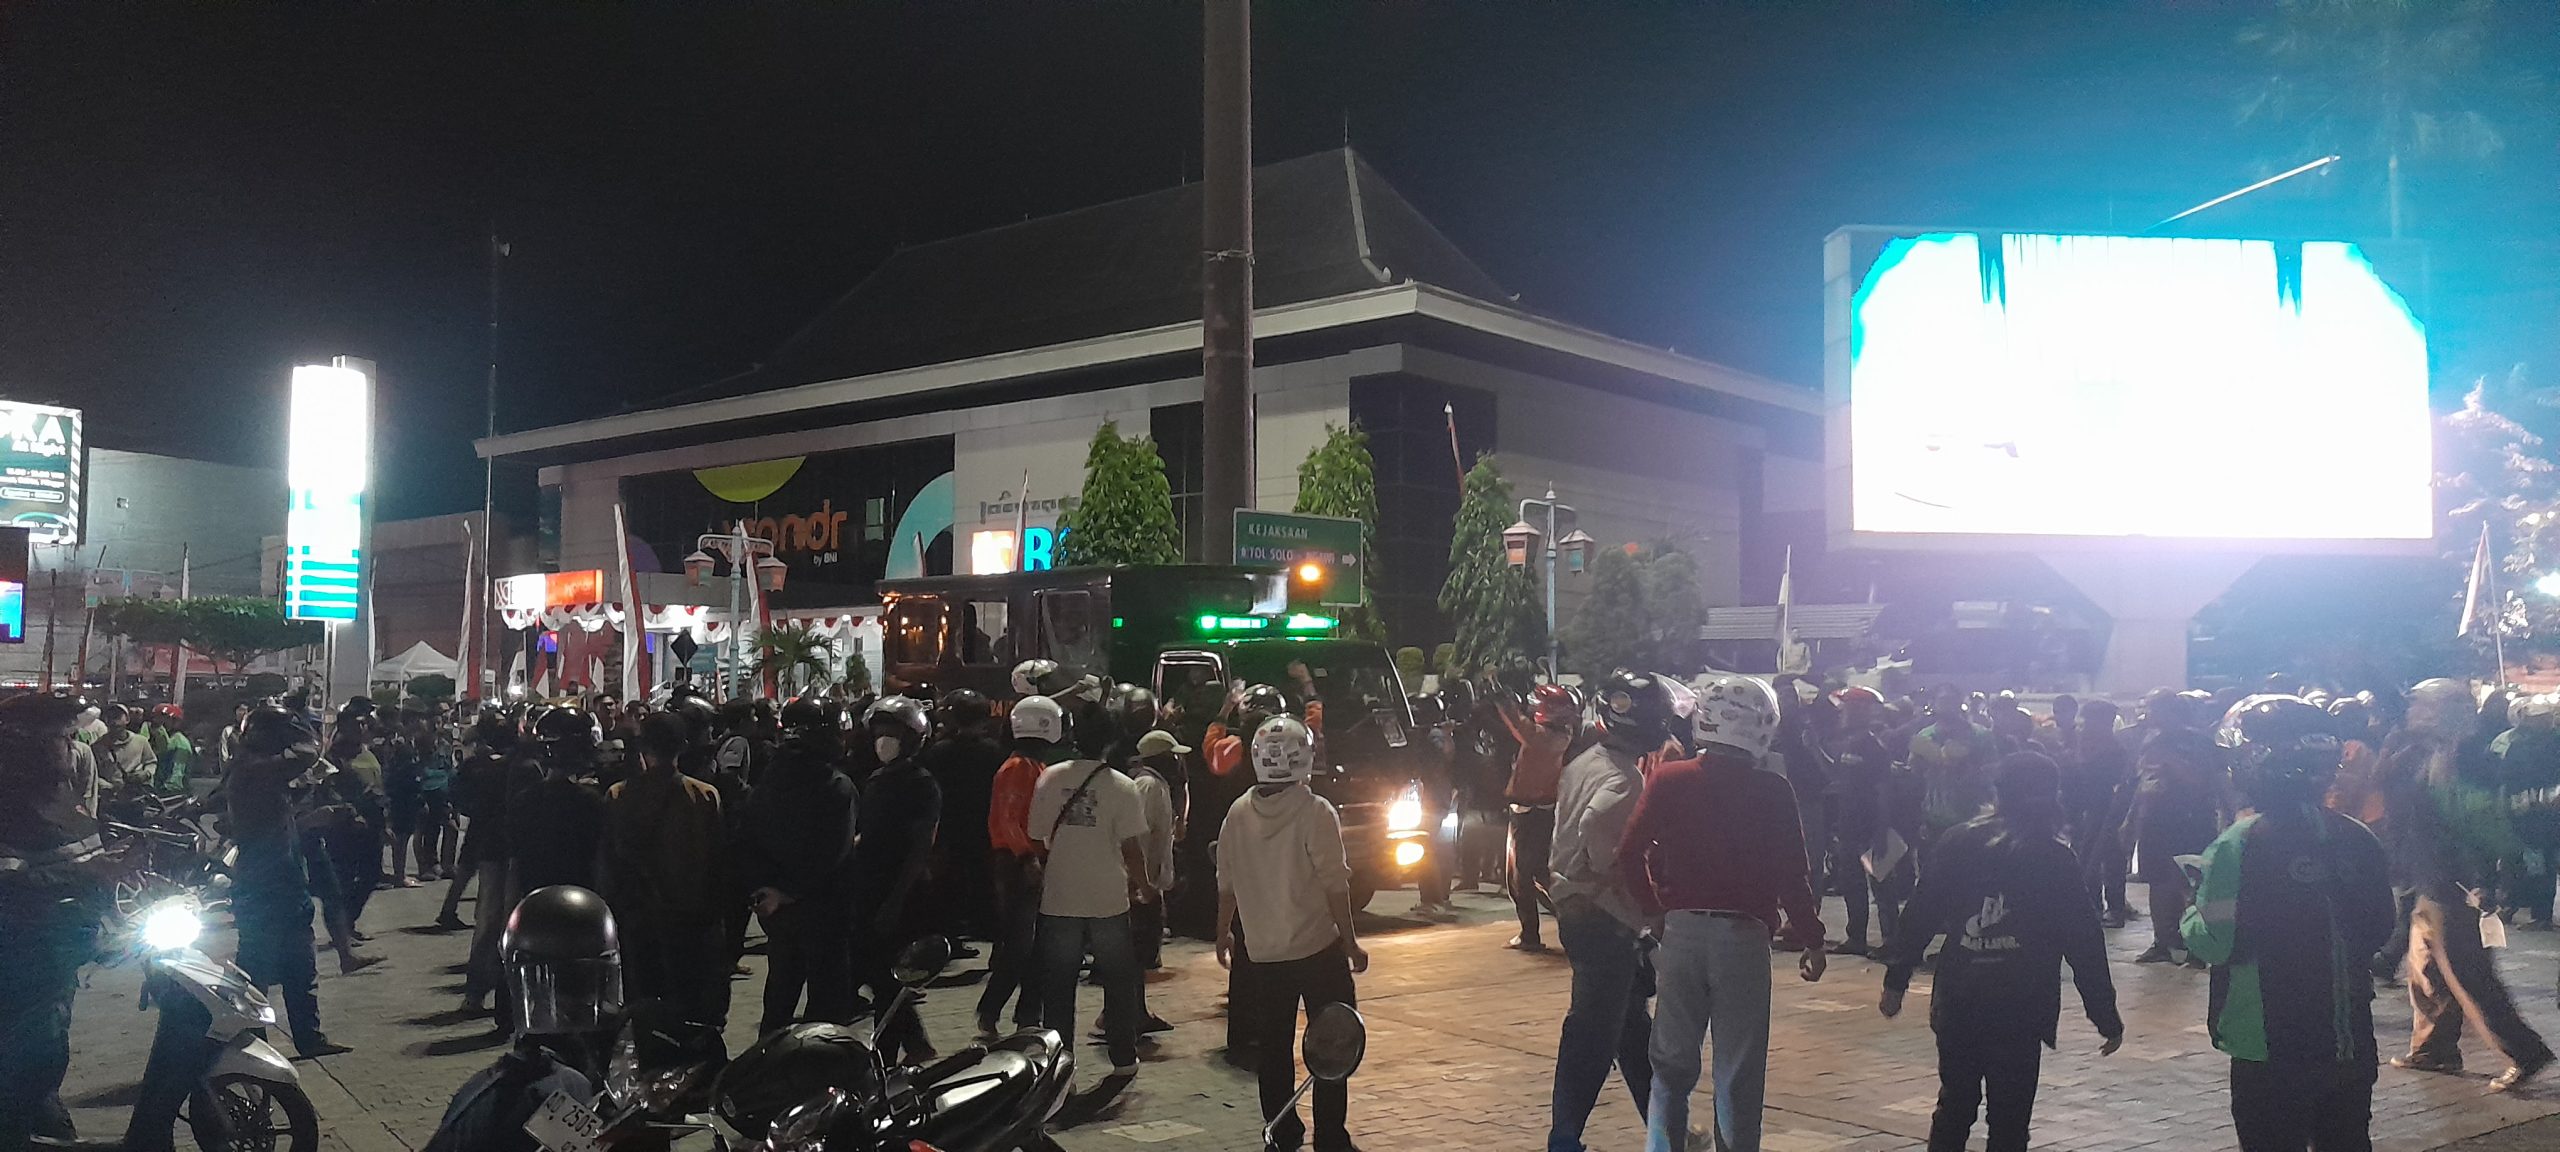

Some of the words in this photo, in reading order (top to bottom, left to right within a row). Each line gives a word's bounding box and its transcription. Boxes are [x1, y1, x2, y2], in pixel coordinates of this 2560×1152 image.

[1248, 523, 1308, 540] KEJAKSAAN
[813, 554, 823, 567] by
[824, 552, 838, 563] BNI
[1250, 547, 1265, 560] TOL
[1270, 549, 1293, 561] SOLO
[562, 1105, 597, 1137] 2505
